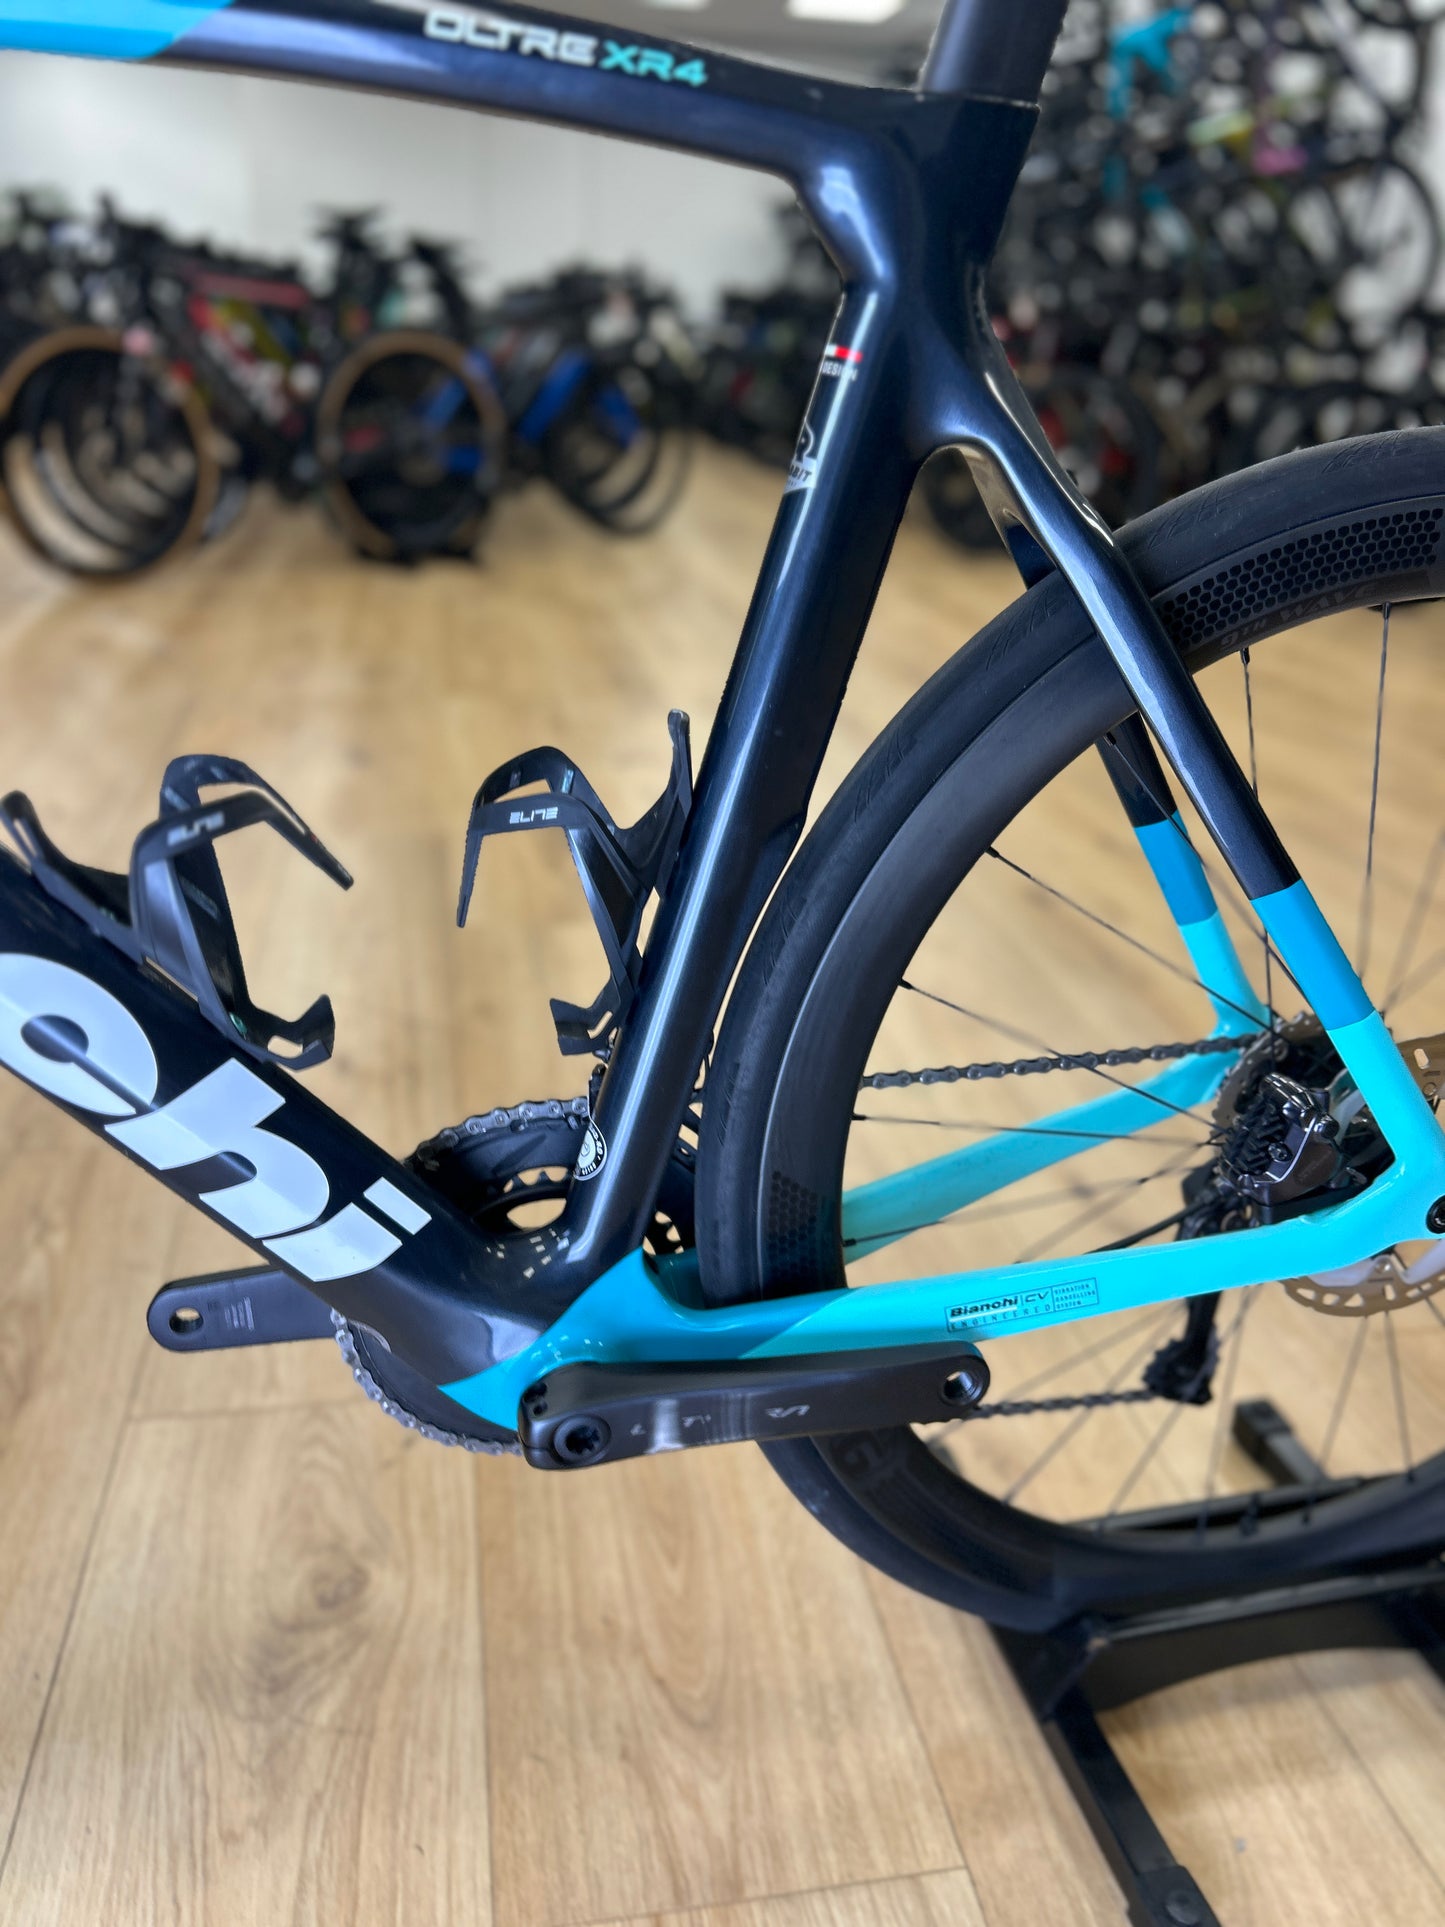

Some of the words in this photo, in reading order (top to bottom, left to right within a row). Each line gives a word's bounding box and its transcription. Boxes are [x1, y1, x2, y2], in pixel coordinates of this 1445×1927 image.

[424, 8, 598, 66] OLTRE
[600, 40, 707, 87] XR4
[509, 806, 559, 824] ELITE
[950, 1295, 1019, 1318] Bianchi
[1025, 1291, 1049, 1304] CV
